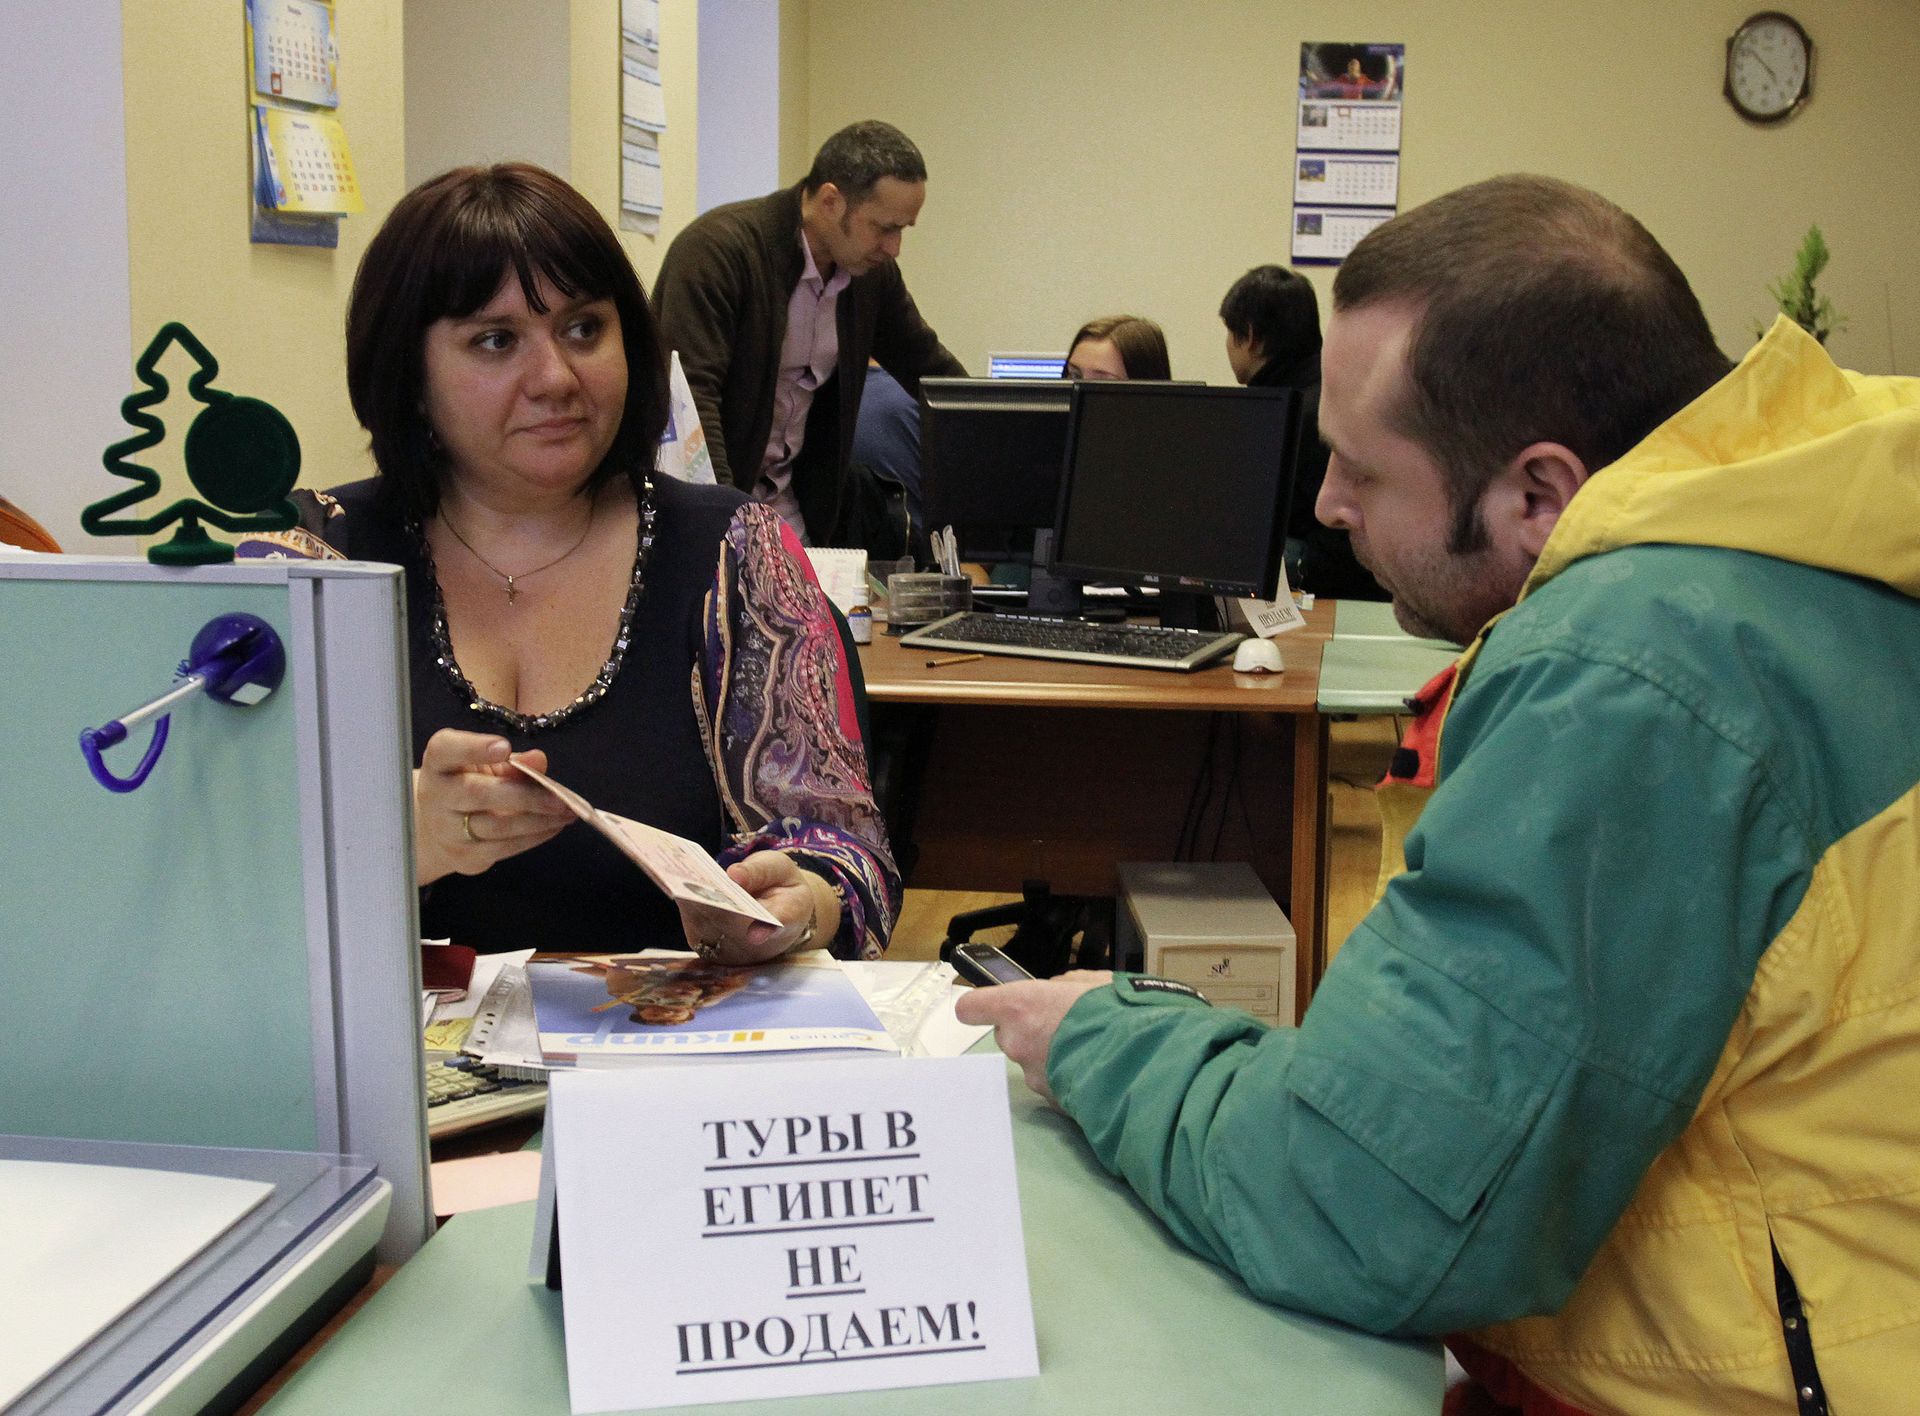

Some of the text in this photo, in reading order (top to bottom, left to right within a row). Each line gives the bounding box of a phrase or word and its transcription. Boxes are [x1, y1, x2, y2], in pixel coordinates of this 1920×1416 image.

[702, 1110, 917, 1160] ТУРЫ В
[702, 1173, 930, 1227] ЕГИПЕТ
[784, 1243, 862, 1288] НЕ
[675, 1300, 979, 1364] ПРОДАЕМ!
